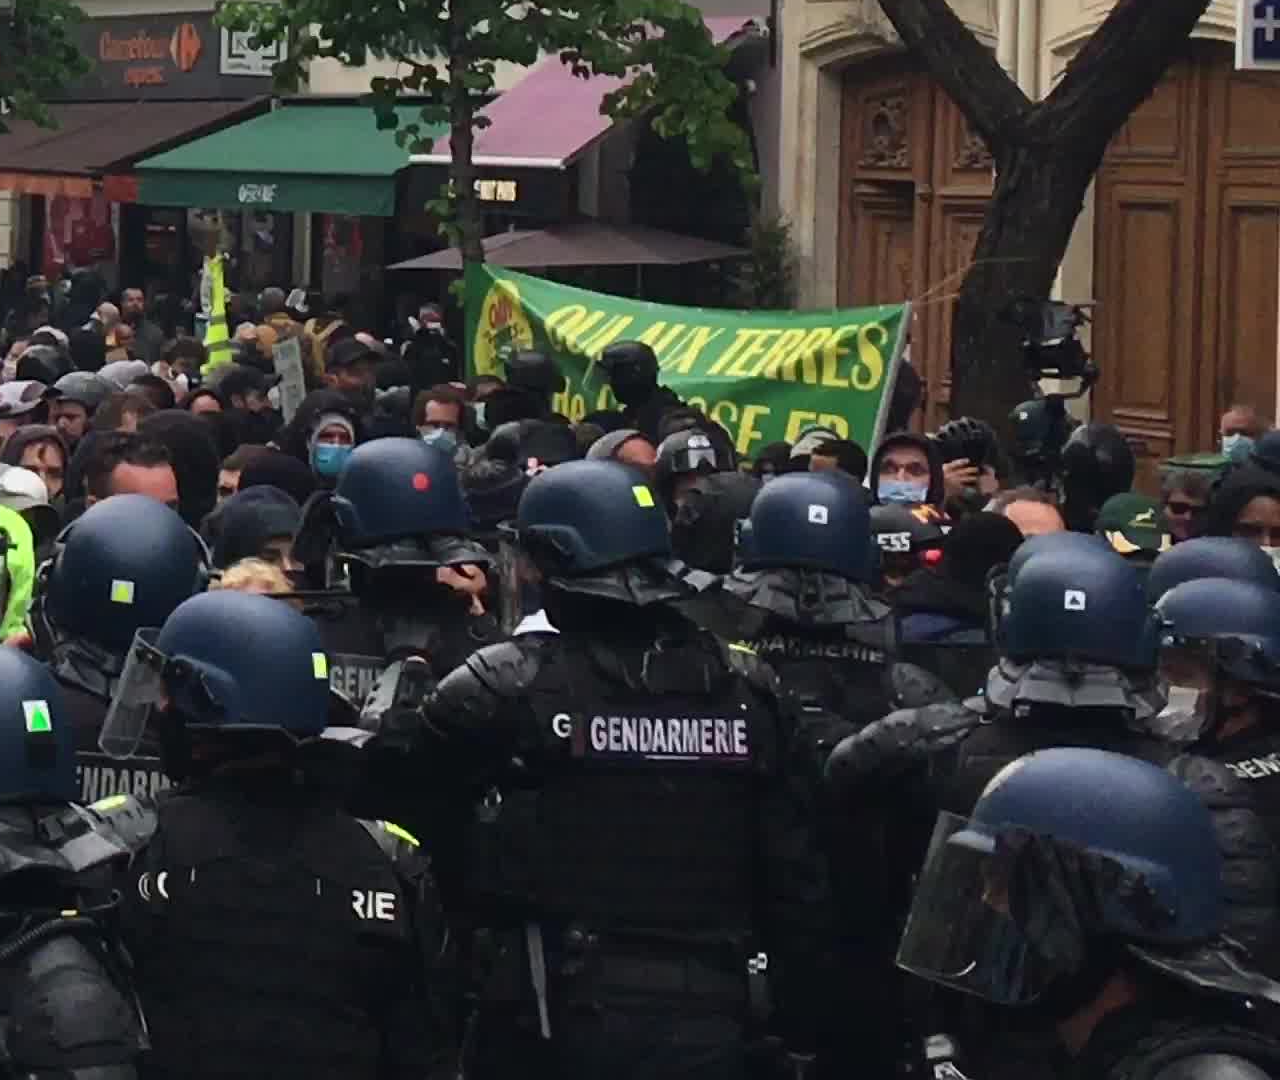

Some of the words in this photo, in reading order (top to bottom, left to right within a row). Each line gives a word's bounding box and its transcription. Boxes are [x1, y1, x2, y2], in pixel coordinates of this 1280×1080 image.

[544, 304, 634, 360] OUI
[637, 321, 727, 375] AUX
[706, 320, 890, 391] TERRES
[591, 717, 749, 754] GENDARMERIE
